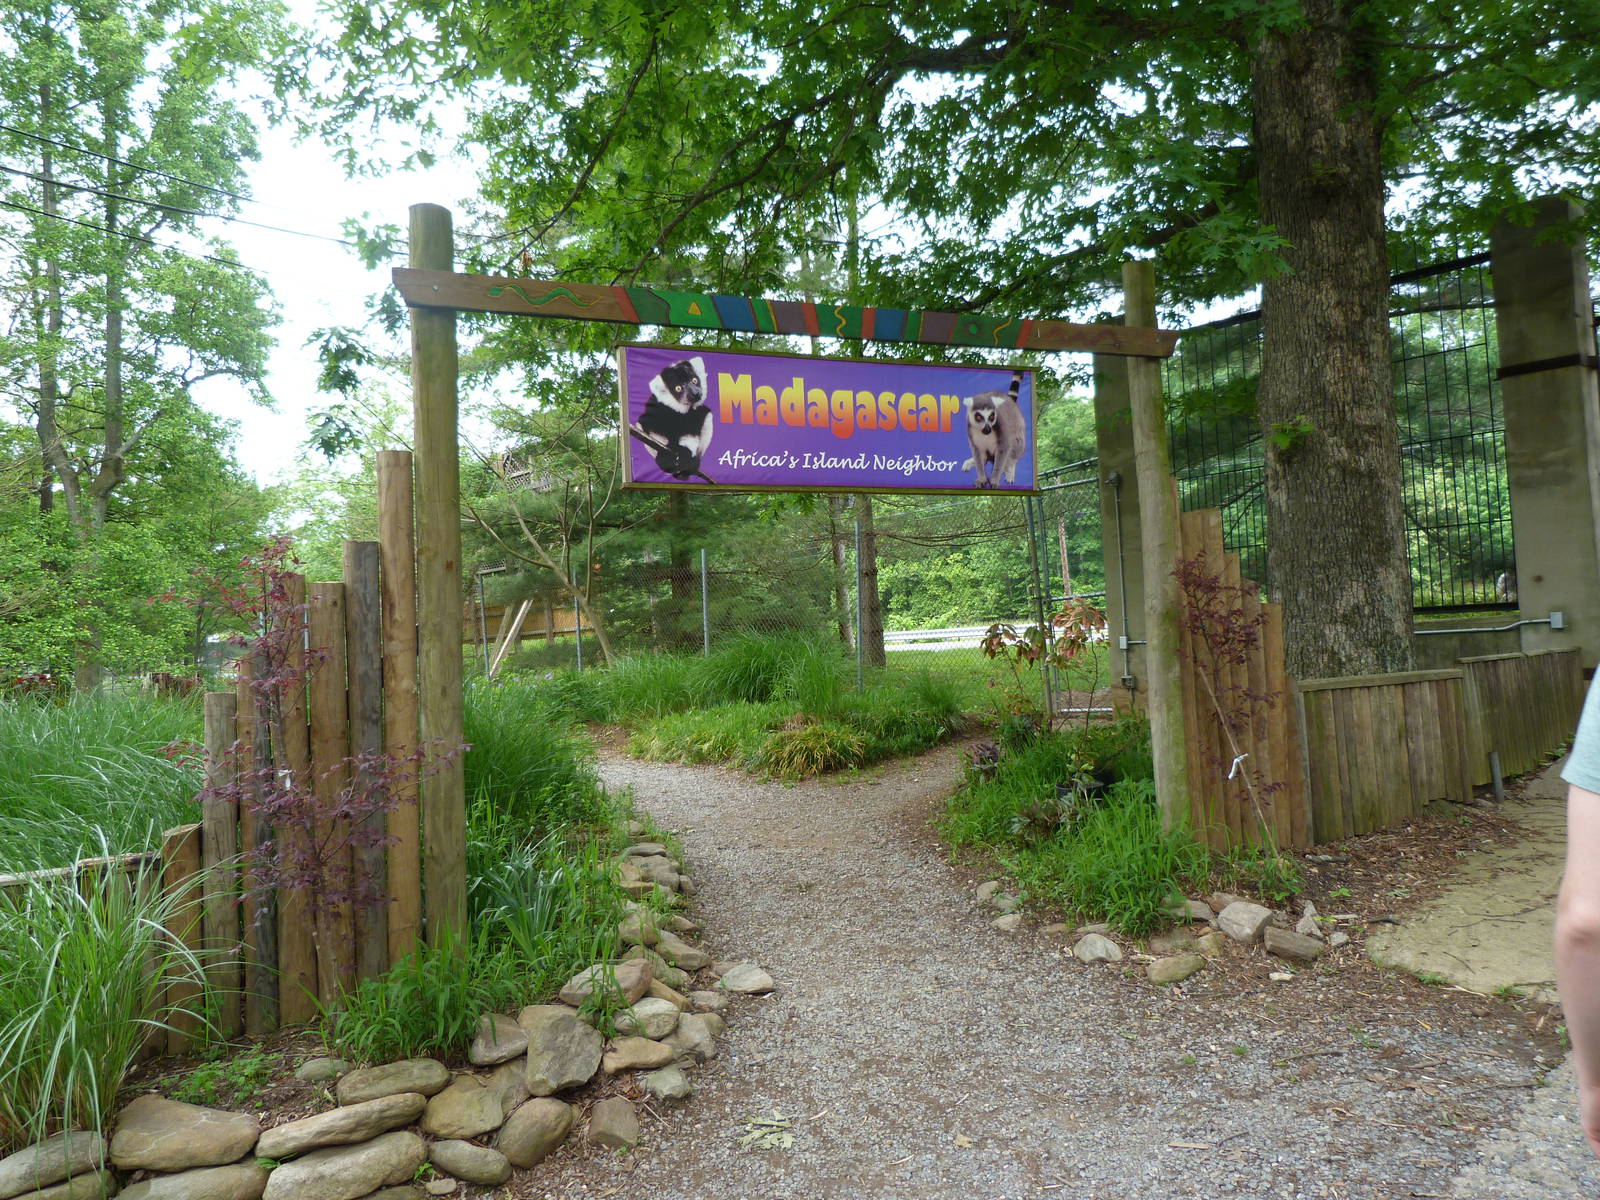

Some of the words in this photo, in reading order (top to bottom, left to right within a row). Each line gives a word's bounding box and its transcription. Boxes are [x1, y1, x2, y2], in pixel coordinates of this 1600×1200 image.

[717, 372, 960, 439] Madagascar
[718, 449, 798, 469] Africa's
[802, 452, 870, 471] Island
[873, 455, 957, 475] Neighbor
